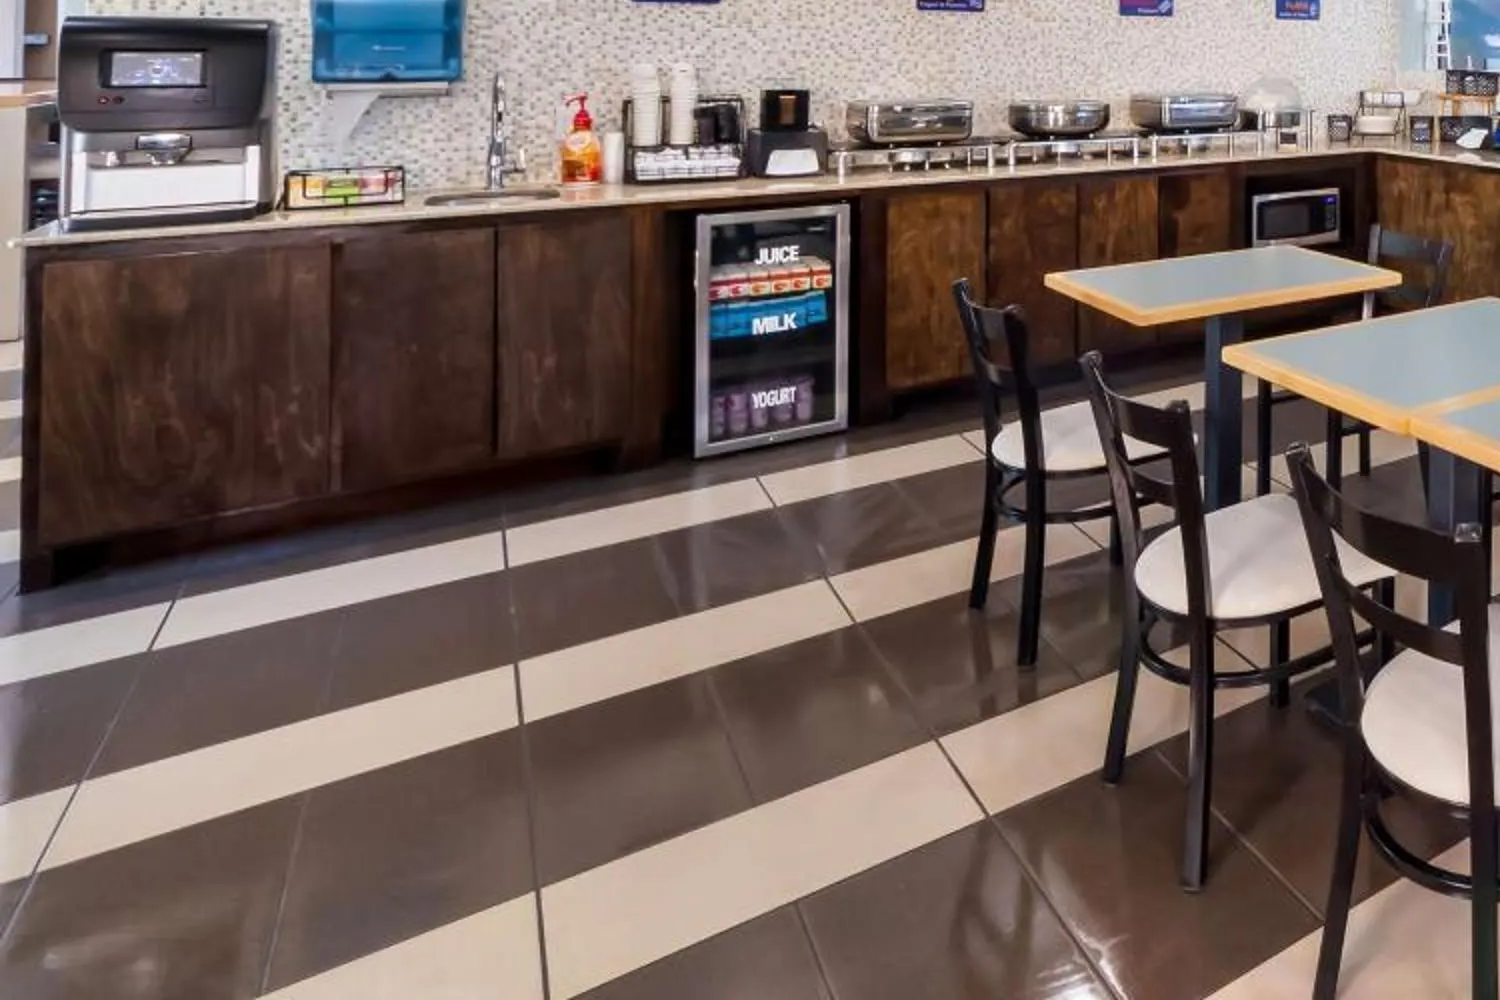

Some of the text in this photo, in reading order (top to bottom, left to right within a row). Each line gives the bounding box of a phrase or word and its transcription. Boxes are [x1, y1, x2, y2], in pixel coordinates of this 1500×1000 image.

[755, 245, 800, 265] JUICE
[752, 312, 797, 335] MILK
[752, 386, 797, 409] YOGURT
